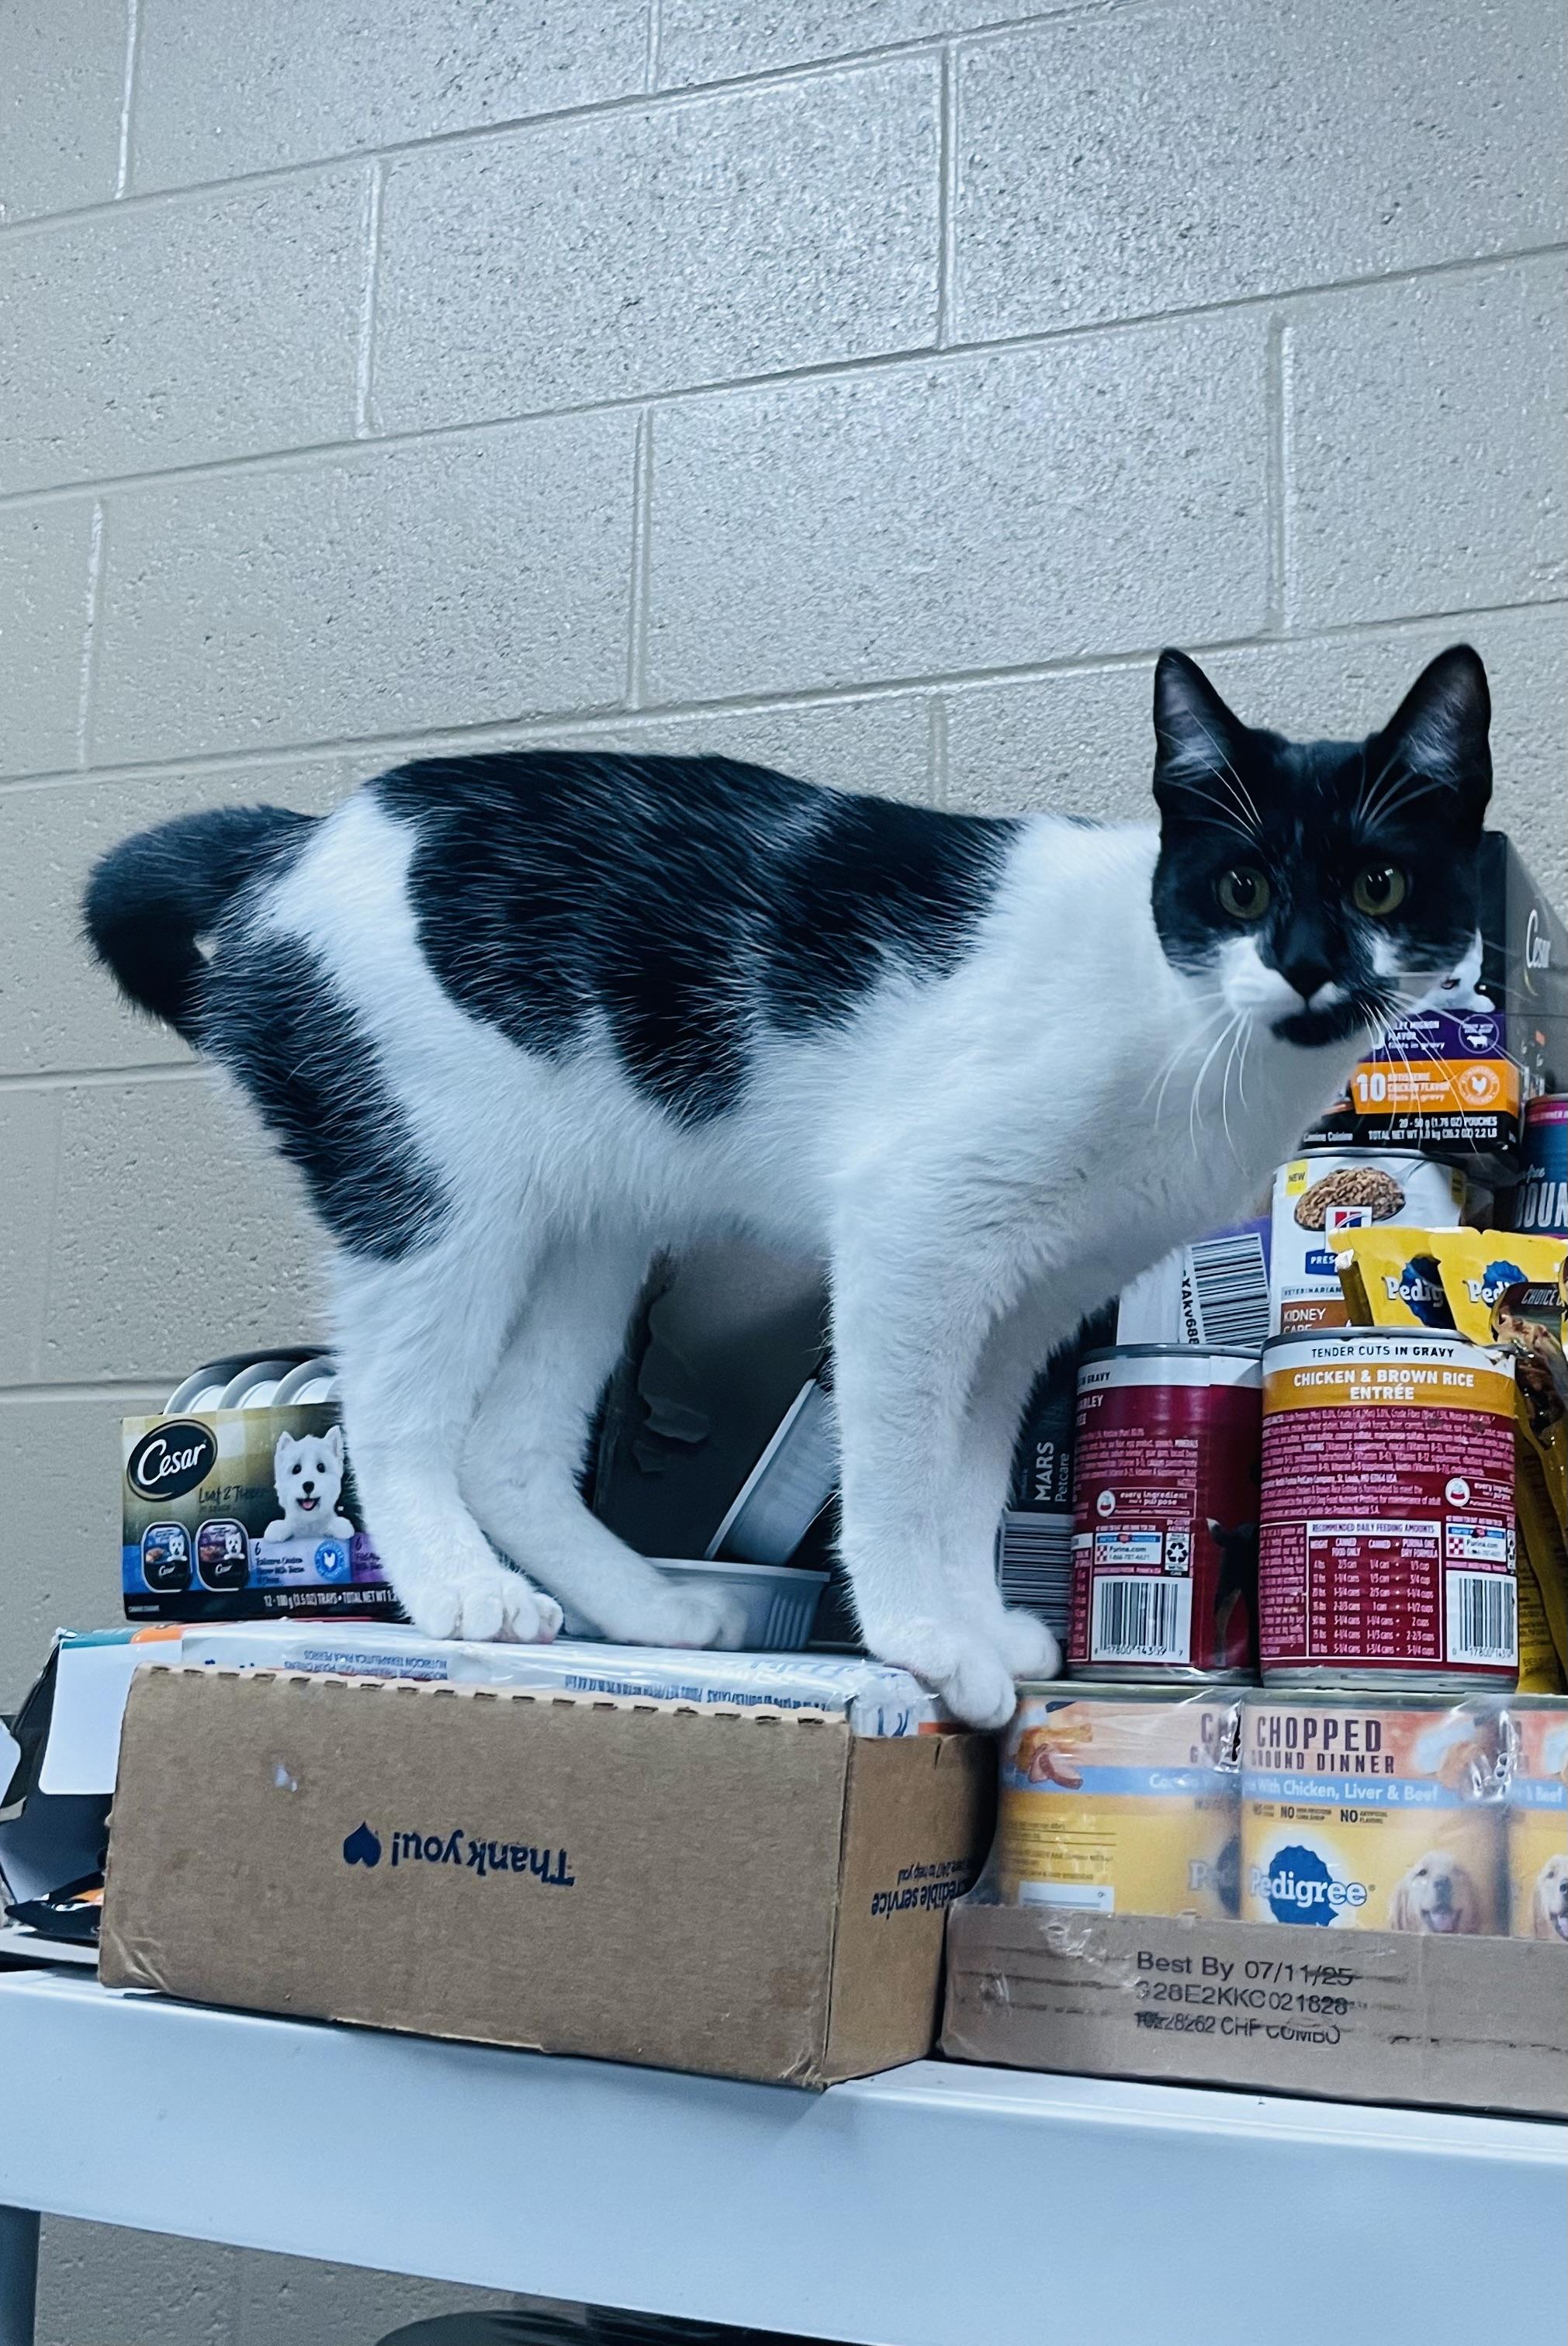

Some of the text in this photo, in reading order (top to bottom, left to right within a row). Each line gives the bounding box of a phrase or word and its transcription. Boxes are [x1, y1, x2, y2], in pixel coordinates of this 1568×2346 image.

[1357, 1073, 1386, 1102] 10
[1464, 1116, 1497, 1126] POUCHES
[1369, 1130, 1390, 1140] TOTAL
[1391, 1130, 1405, 1140] NET
[1407, 1130, 1418, 1140] WT
[1431, 1130, 1441, 1140] kg
[1476, 1128, 1487, 1138] 2.2
[1488, 1127, 1498, 1138] LB
[1288, 1172, 1305, 1183] NEW
[1521, 1288, 1558, 1306] CHOICE
[1283, 1308, 1327, 1322] KIDNEY
[1311, 1346, 1455, 1358] TENDER CUTS IN GRAVY
[1293, 1369, 1475, 1387] CHICKEN & BROWN RICE
[1349, 1384, 1415, 1401] ENTRÉE
[137, 1438, 207, 1486] Cesar
[1034, 1441, 1054, 1501] MARS
[1055, 1453, 1070, 1502] Petcare
[1312, 1523, 1435, 1534] RECOMMENDED DAILY FEEDING AMOUNTS
[254, 1542, 261, 1556] 6
[264, 1595, 273, 1607] 12
[342, 1591, 362, 1604] TOTAL
[362, 1590, 376, 1603] NET
[376, 1590, 386, 1602] WT
[1256, 1715, 1382, 1753] CHOPPED
[1316, 1753, 1394, 1774] DINNER
[1258, 1778, 1438, 1801] With Chicken, Liver & Beef
[1280, 1805, 1295, 1819] NO
[1340, 1809, 1359, 1823] NO
[390, 1829, 576, 1888] Thank you!
[1251, 1867, 1368, 1908] Pedigree
[871, 1887, 919, 1920] service
[1137, 1950, 1355, 1986] Best By 07/11/25
